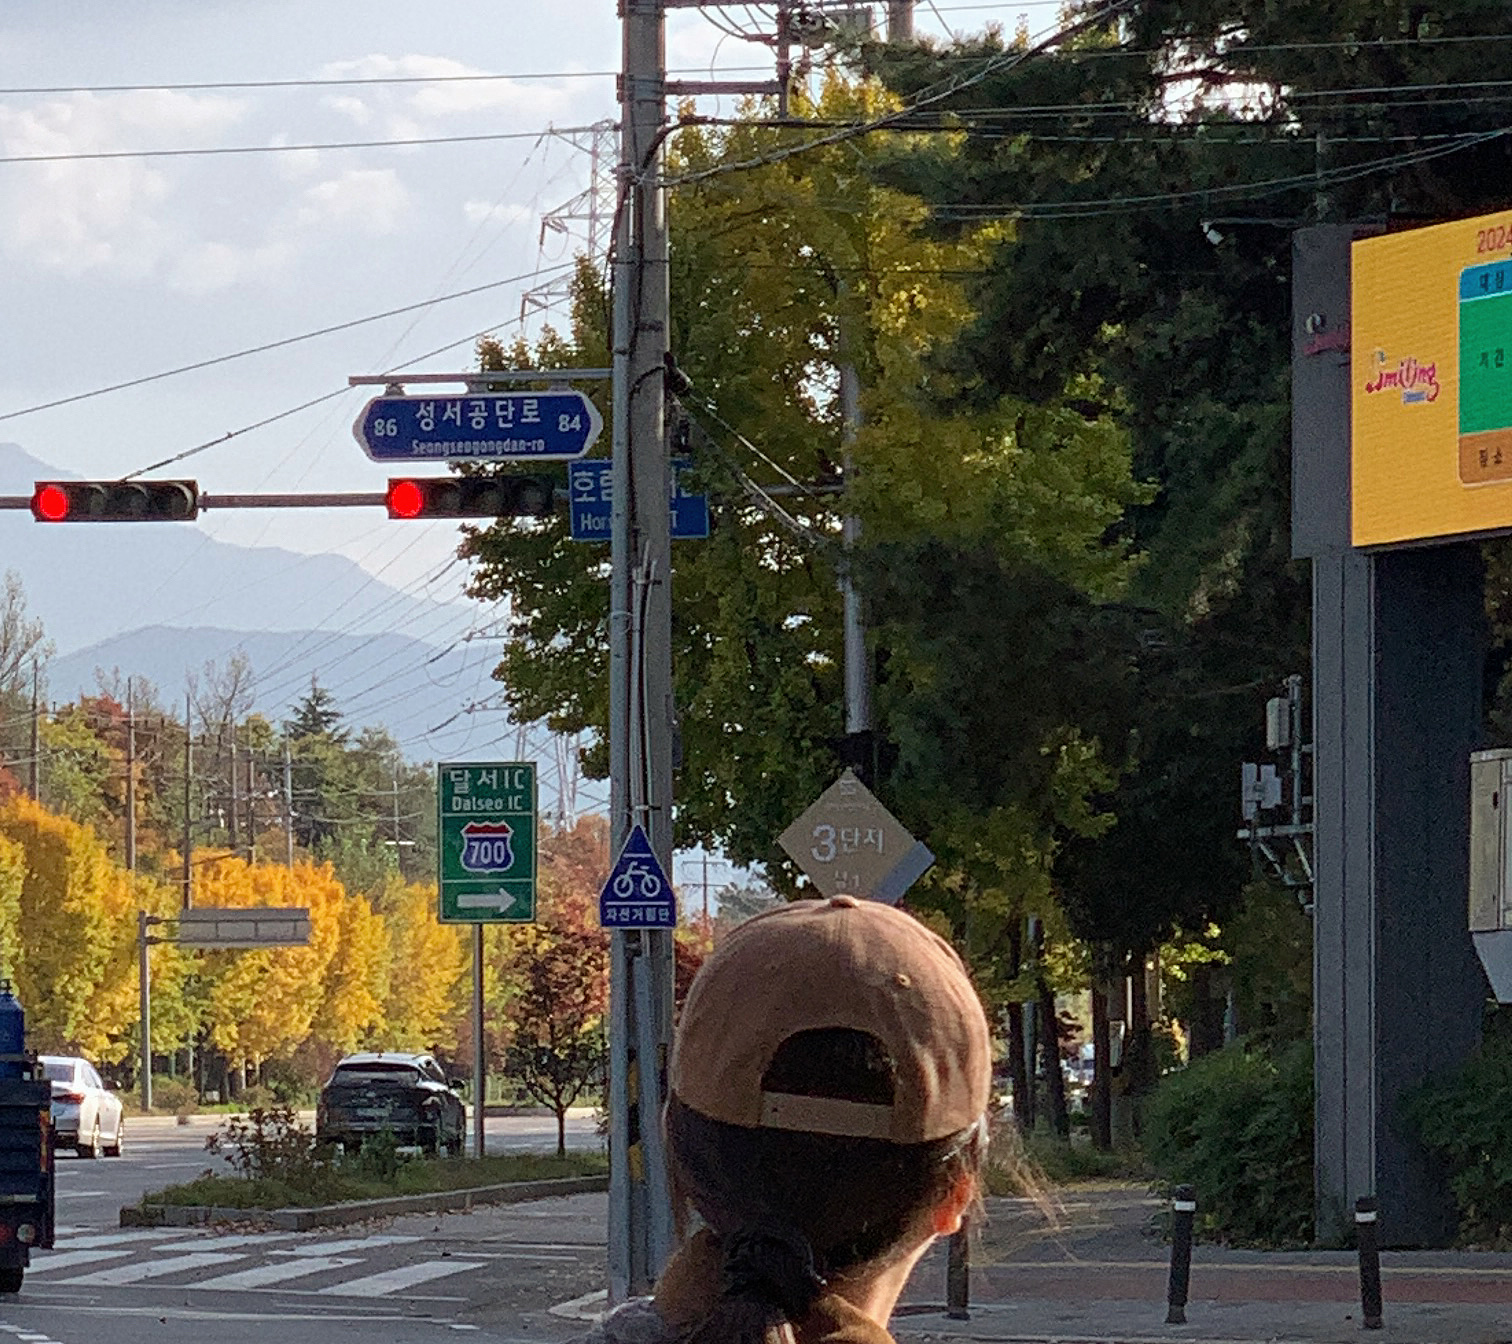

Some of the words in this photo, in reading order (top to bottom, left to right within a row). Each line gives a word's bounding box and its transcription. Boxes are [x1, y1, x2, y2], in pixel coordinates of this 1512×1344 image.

[415, 399, 541, 432] 성서공단로
[558, 414, 581, 432] 84
[374, 418, 398, 437] 86
[451, 795, 504, 811] Dalseo
[507, 795, 523, 810] IC
[469, 841, 505, 864] 700
